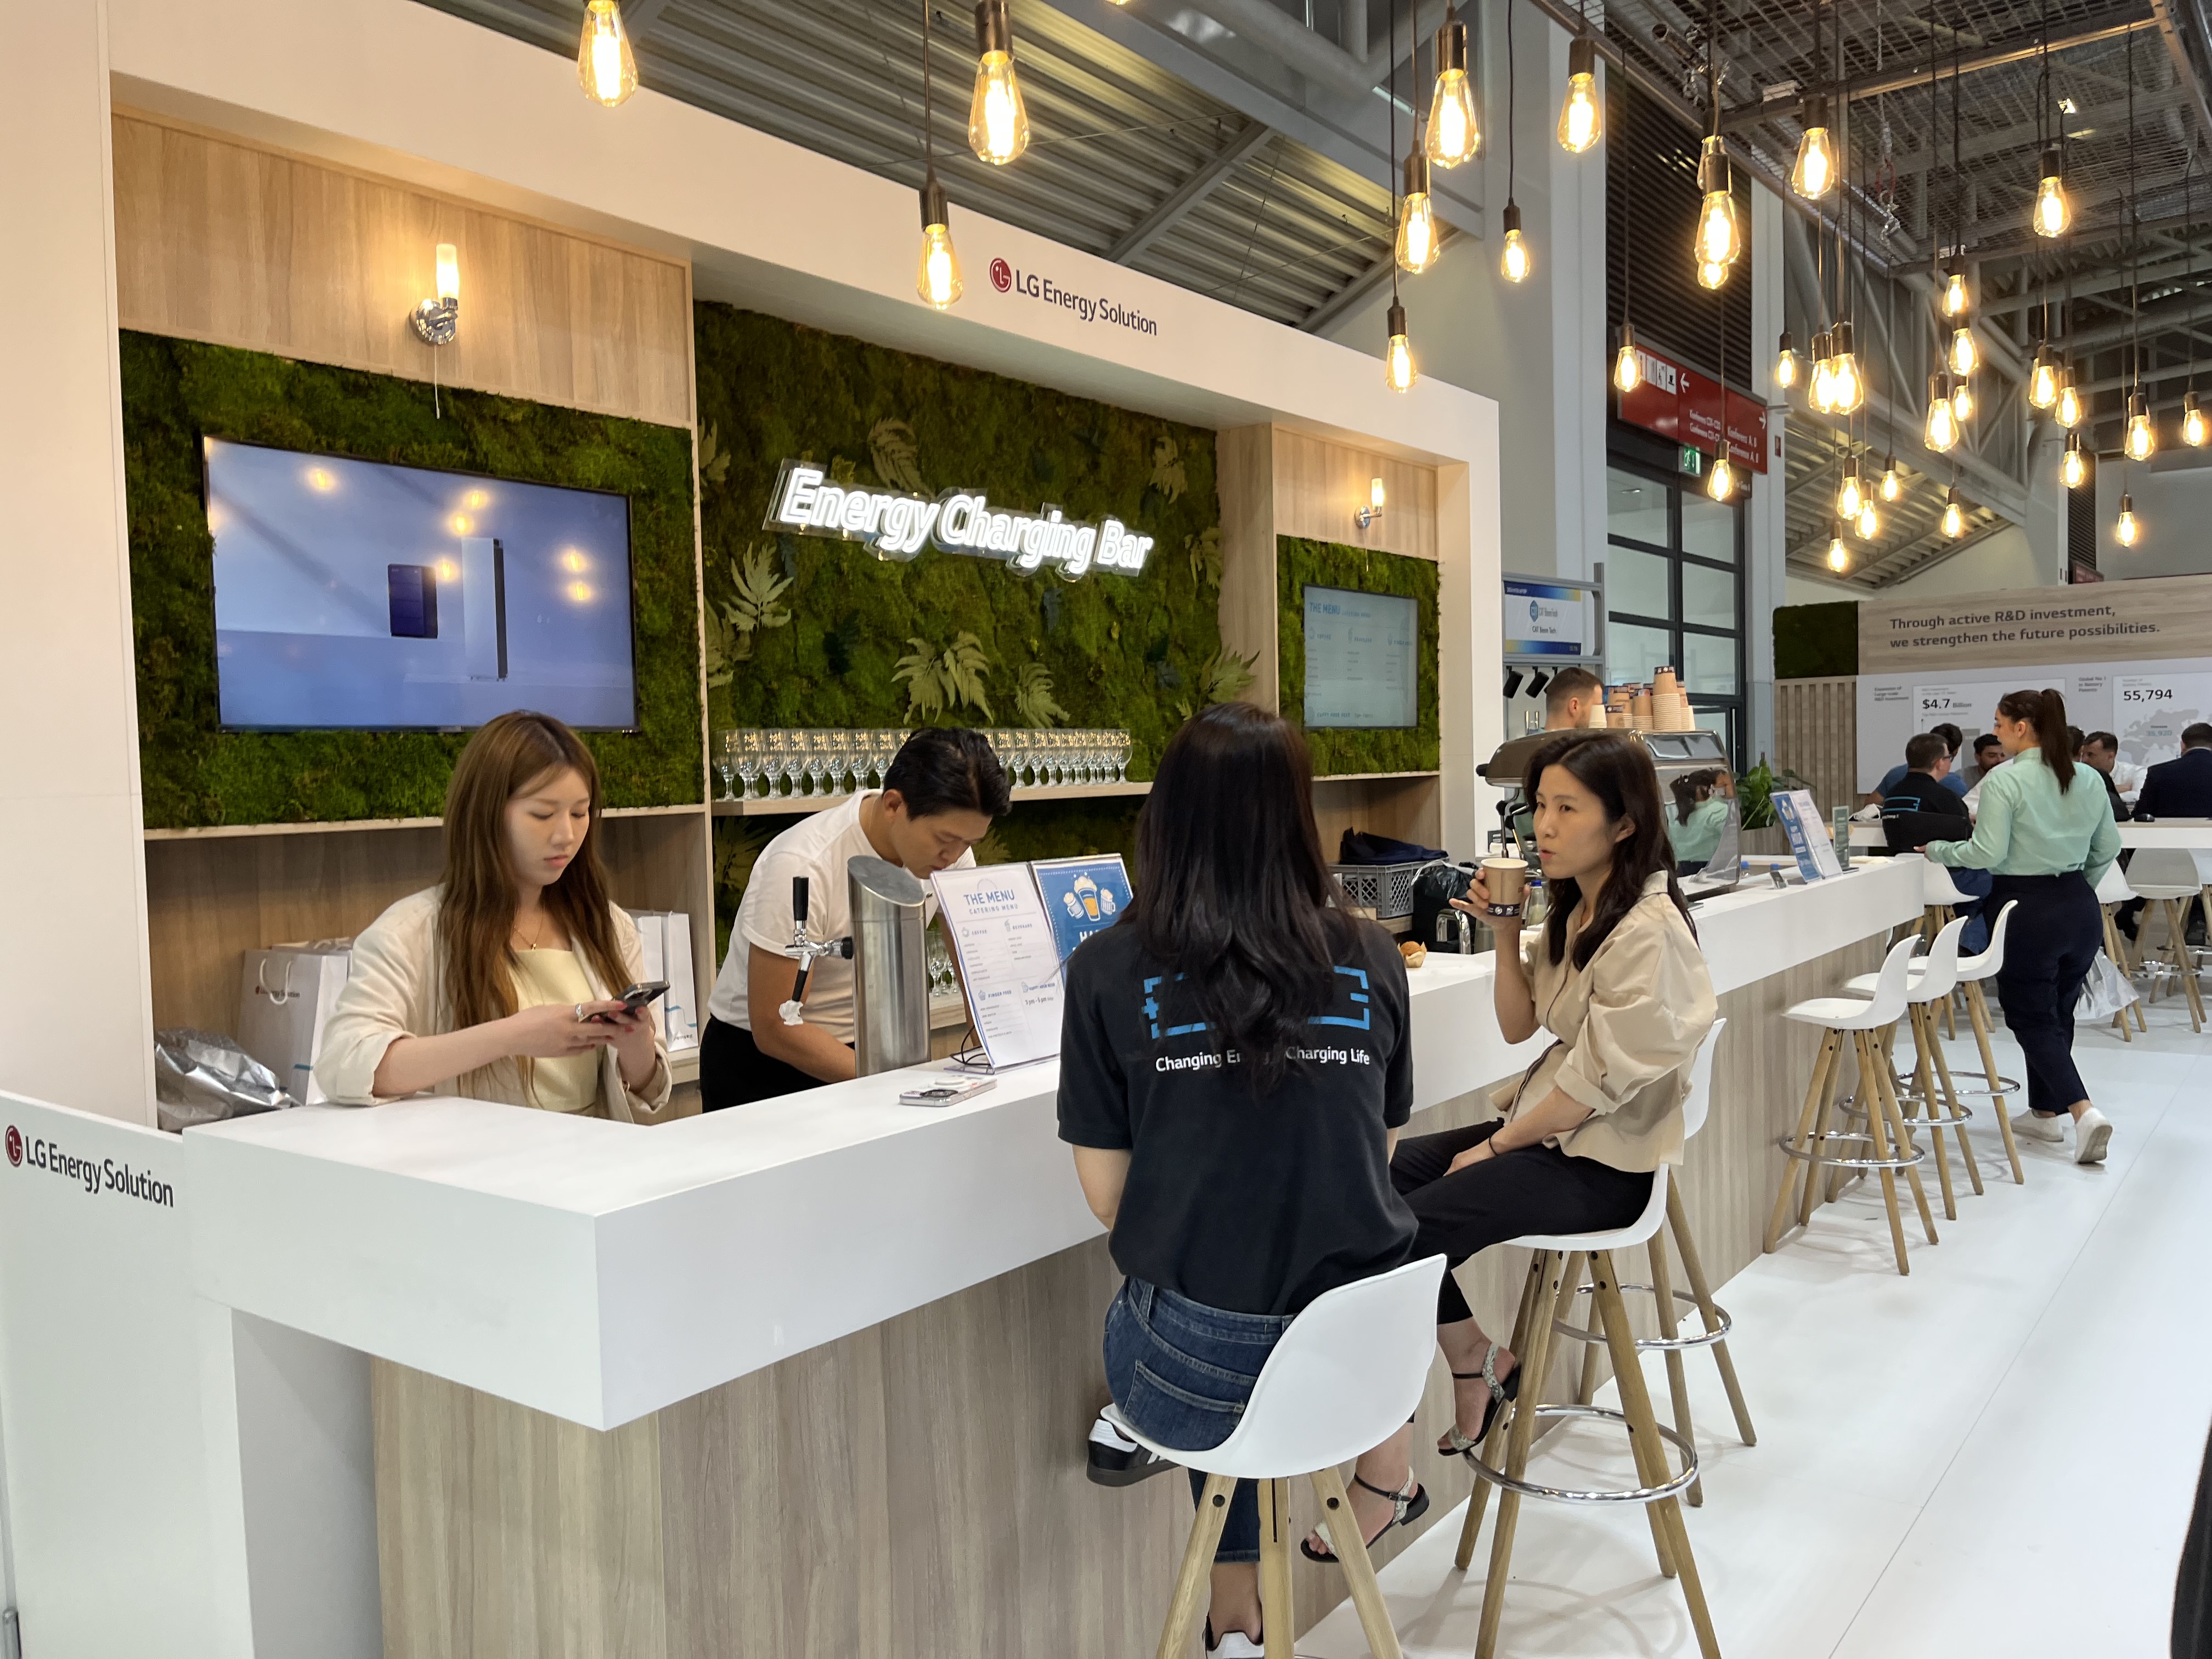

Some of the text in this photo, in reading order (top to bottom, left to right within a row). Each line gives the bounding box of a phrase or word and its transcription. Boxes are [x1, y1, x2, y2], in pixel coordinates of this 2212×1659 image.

[1016, 269, 1157, 336] LG Energy Solution
[780, 467, 1154, 574] Energy Charging Bar
[1310, 602, 1321, 613] THE
[1323, 604, 1340, 614] MENU
[1890, 606, 2116, 630] Through active R&D investment,
[1890, 623, 2160, 647] we strengthen the future possibilities.
[1922, 698, 1950, 709] $4.7
[2124, 689, 2173, 703] 55,794
[963, 889, 1015, 905] THE MENU
[969, 906, 1000, 915] CATERING
[1155, 1051, 1222, 1073] Changing
[1285, 1046, 1347, 1064] Charging
[1351, 1048, 1370, 1065] Life
[25, 1135, 173, 1208] LG Energy Solution
